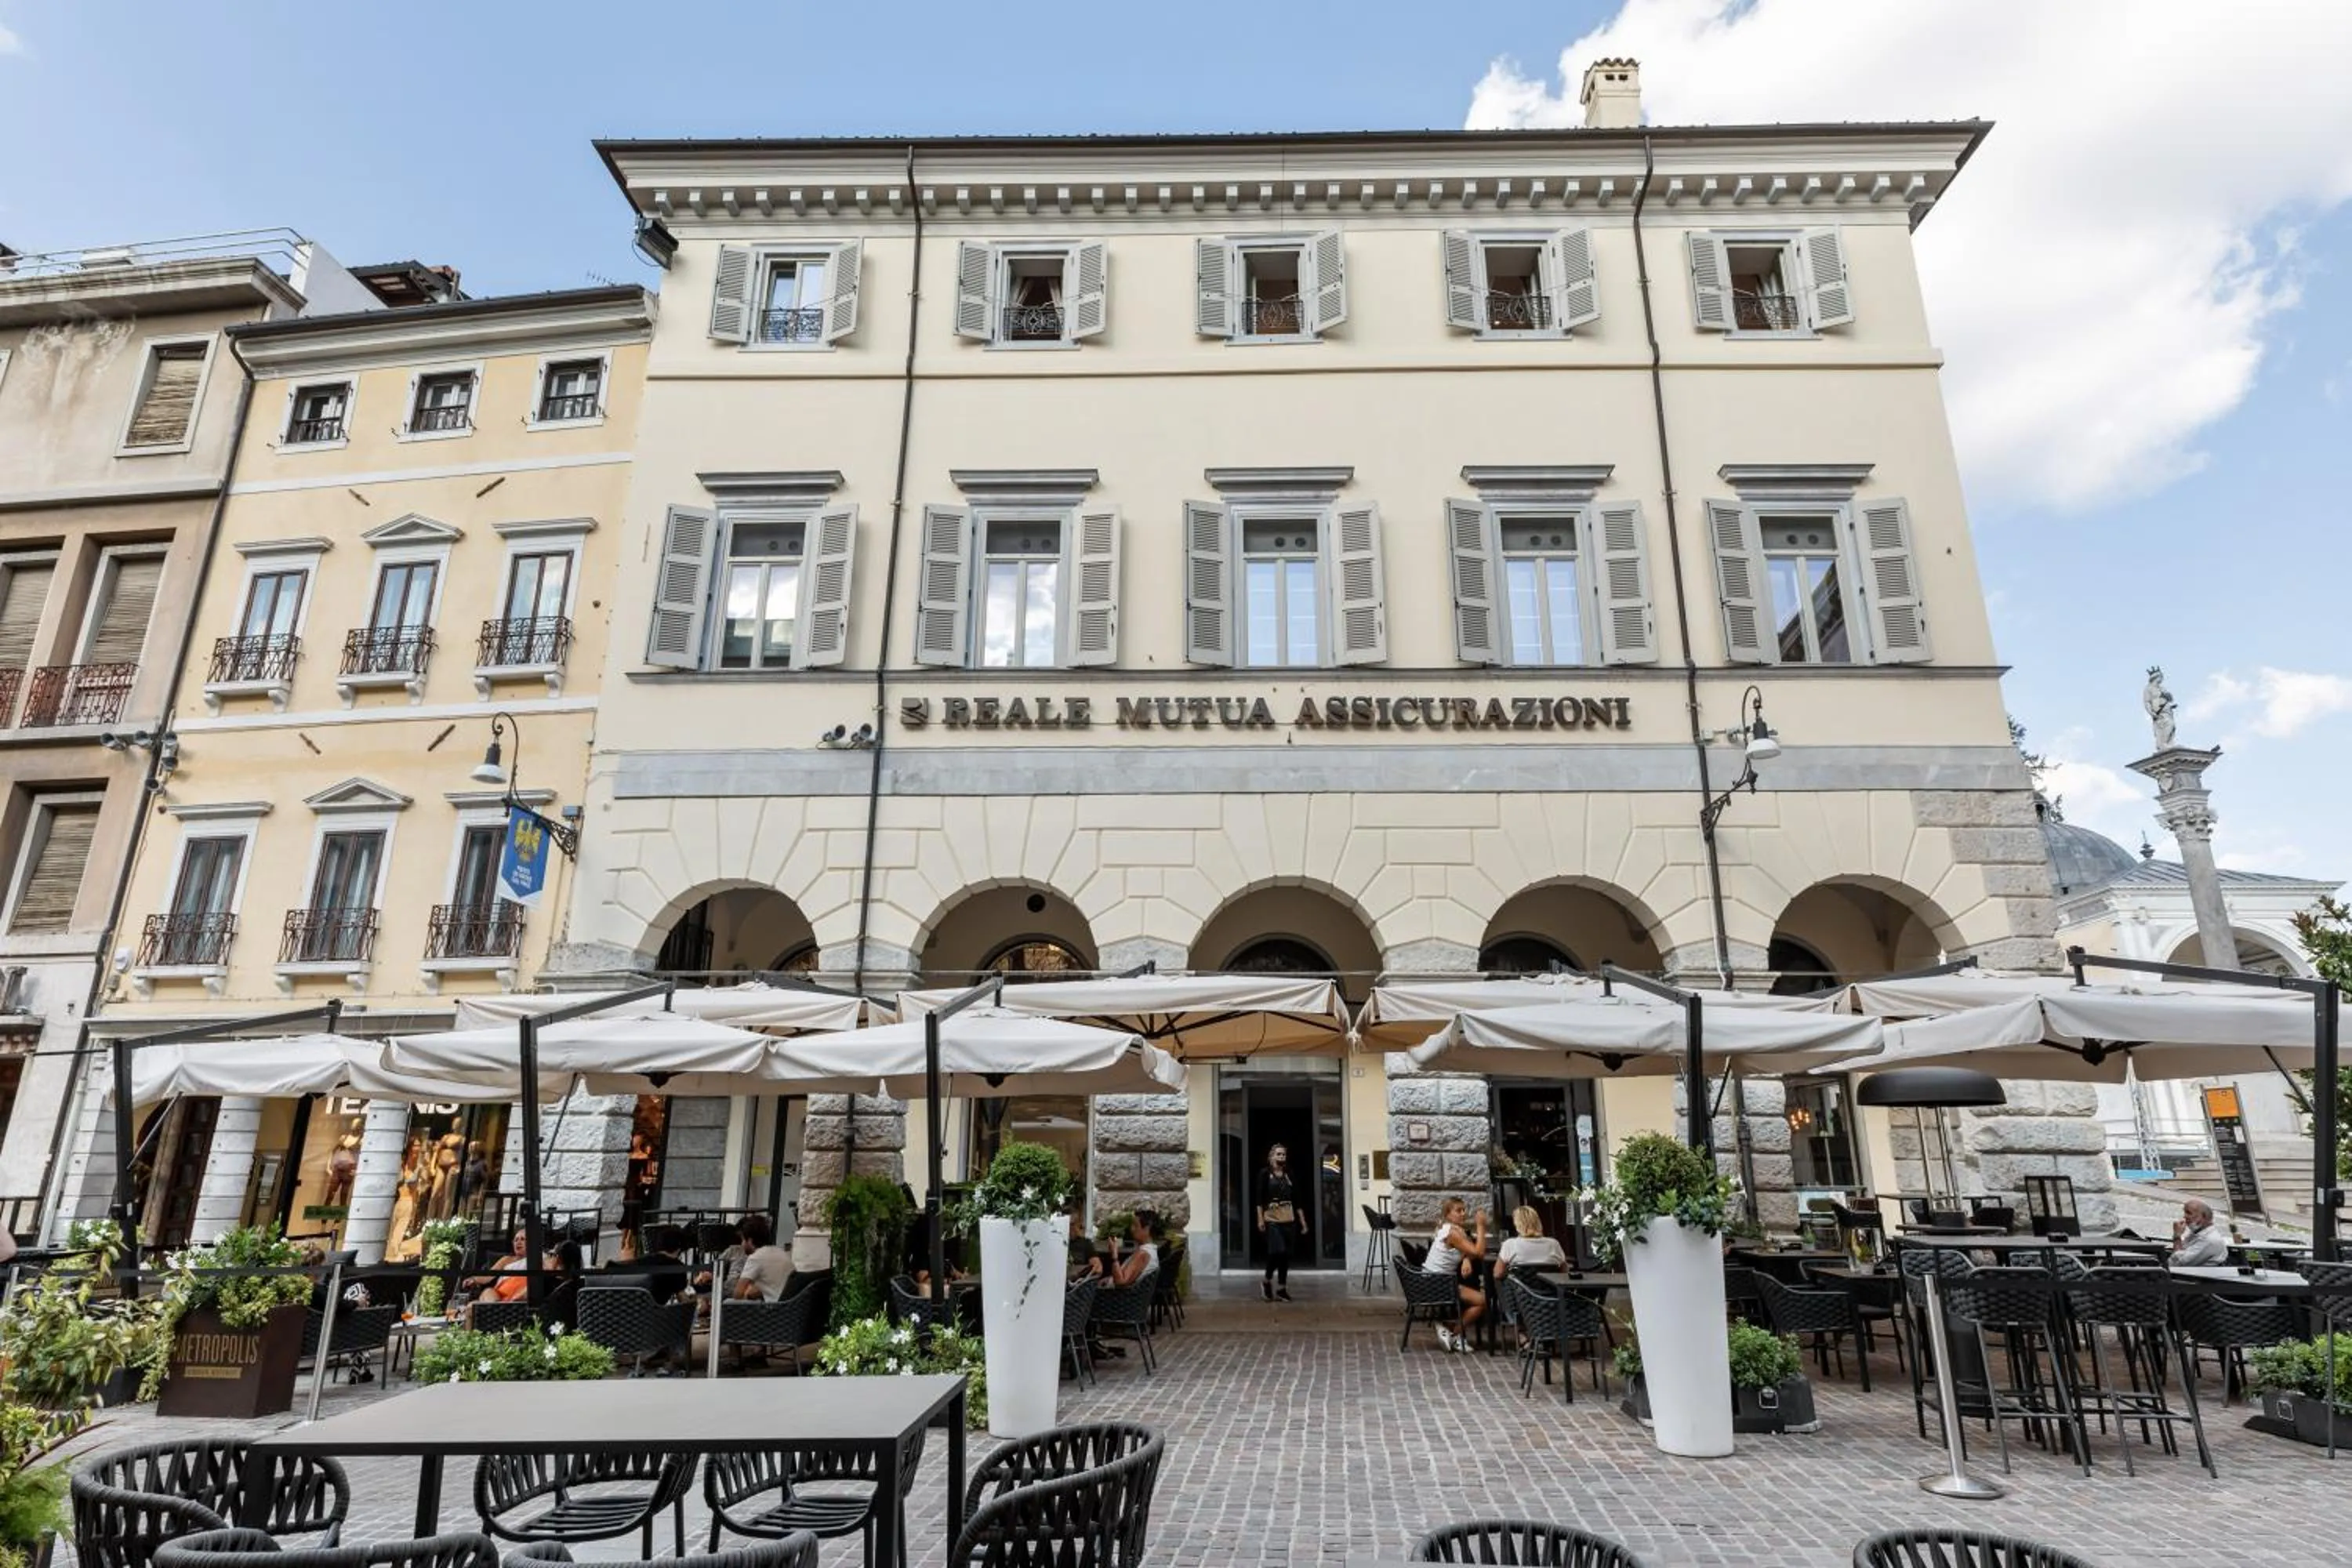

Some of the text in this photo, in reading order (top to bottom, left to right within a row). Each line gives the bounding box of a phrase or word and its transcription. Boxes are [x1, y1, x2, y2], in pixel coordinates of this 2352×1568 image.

[942, 695, 1632, 730] REALE MUTUA ASSICURAZIONI
[176, 1333, 260, 1363] METROPOLIS
